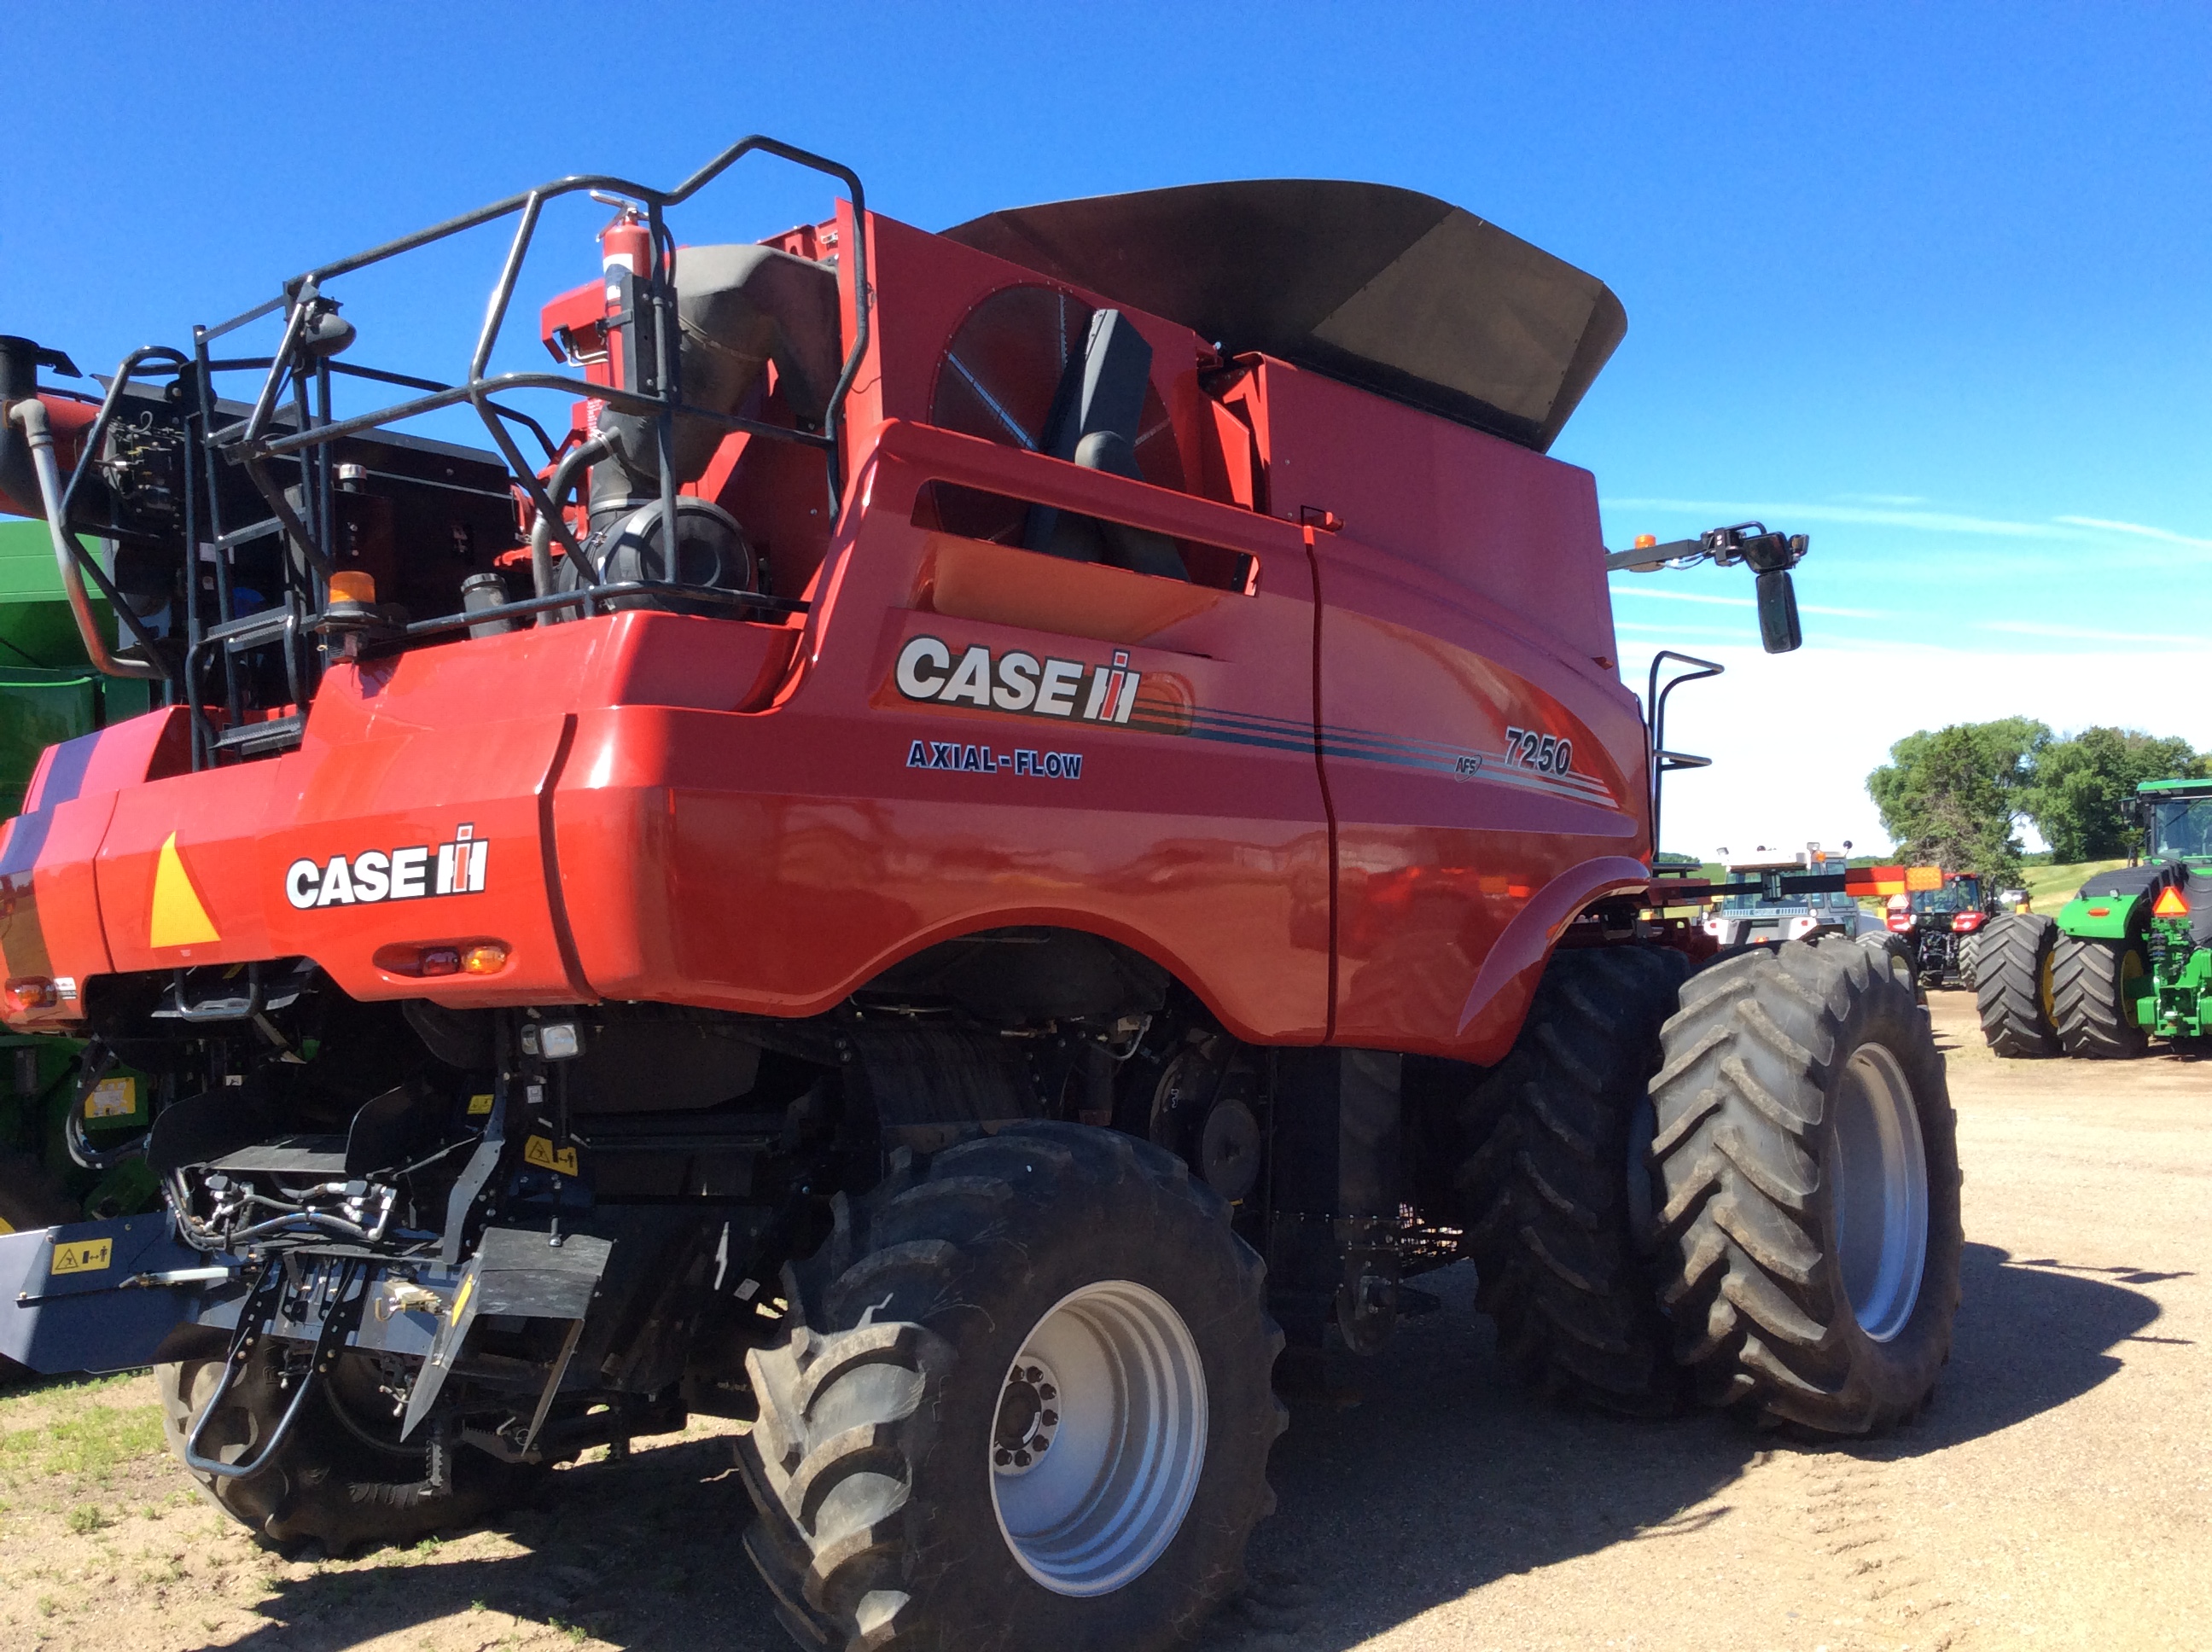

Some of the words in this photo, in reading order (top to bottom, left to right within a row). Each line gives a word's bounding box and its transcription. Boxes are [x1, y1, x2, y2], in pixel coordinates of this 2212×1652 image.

[894, 635, 1084, 718] CASE
[906, 740, 1083, 779] AXIAL-FLOW
[1454, 755, 1477, 775] AFS
[1505, 725, 1573, 777] 7250
[285, 845, 428, 910] CASE
